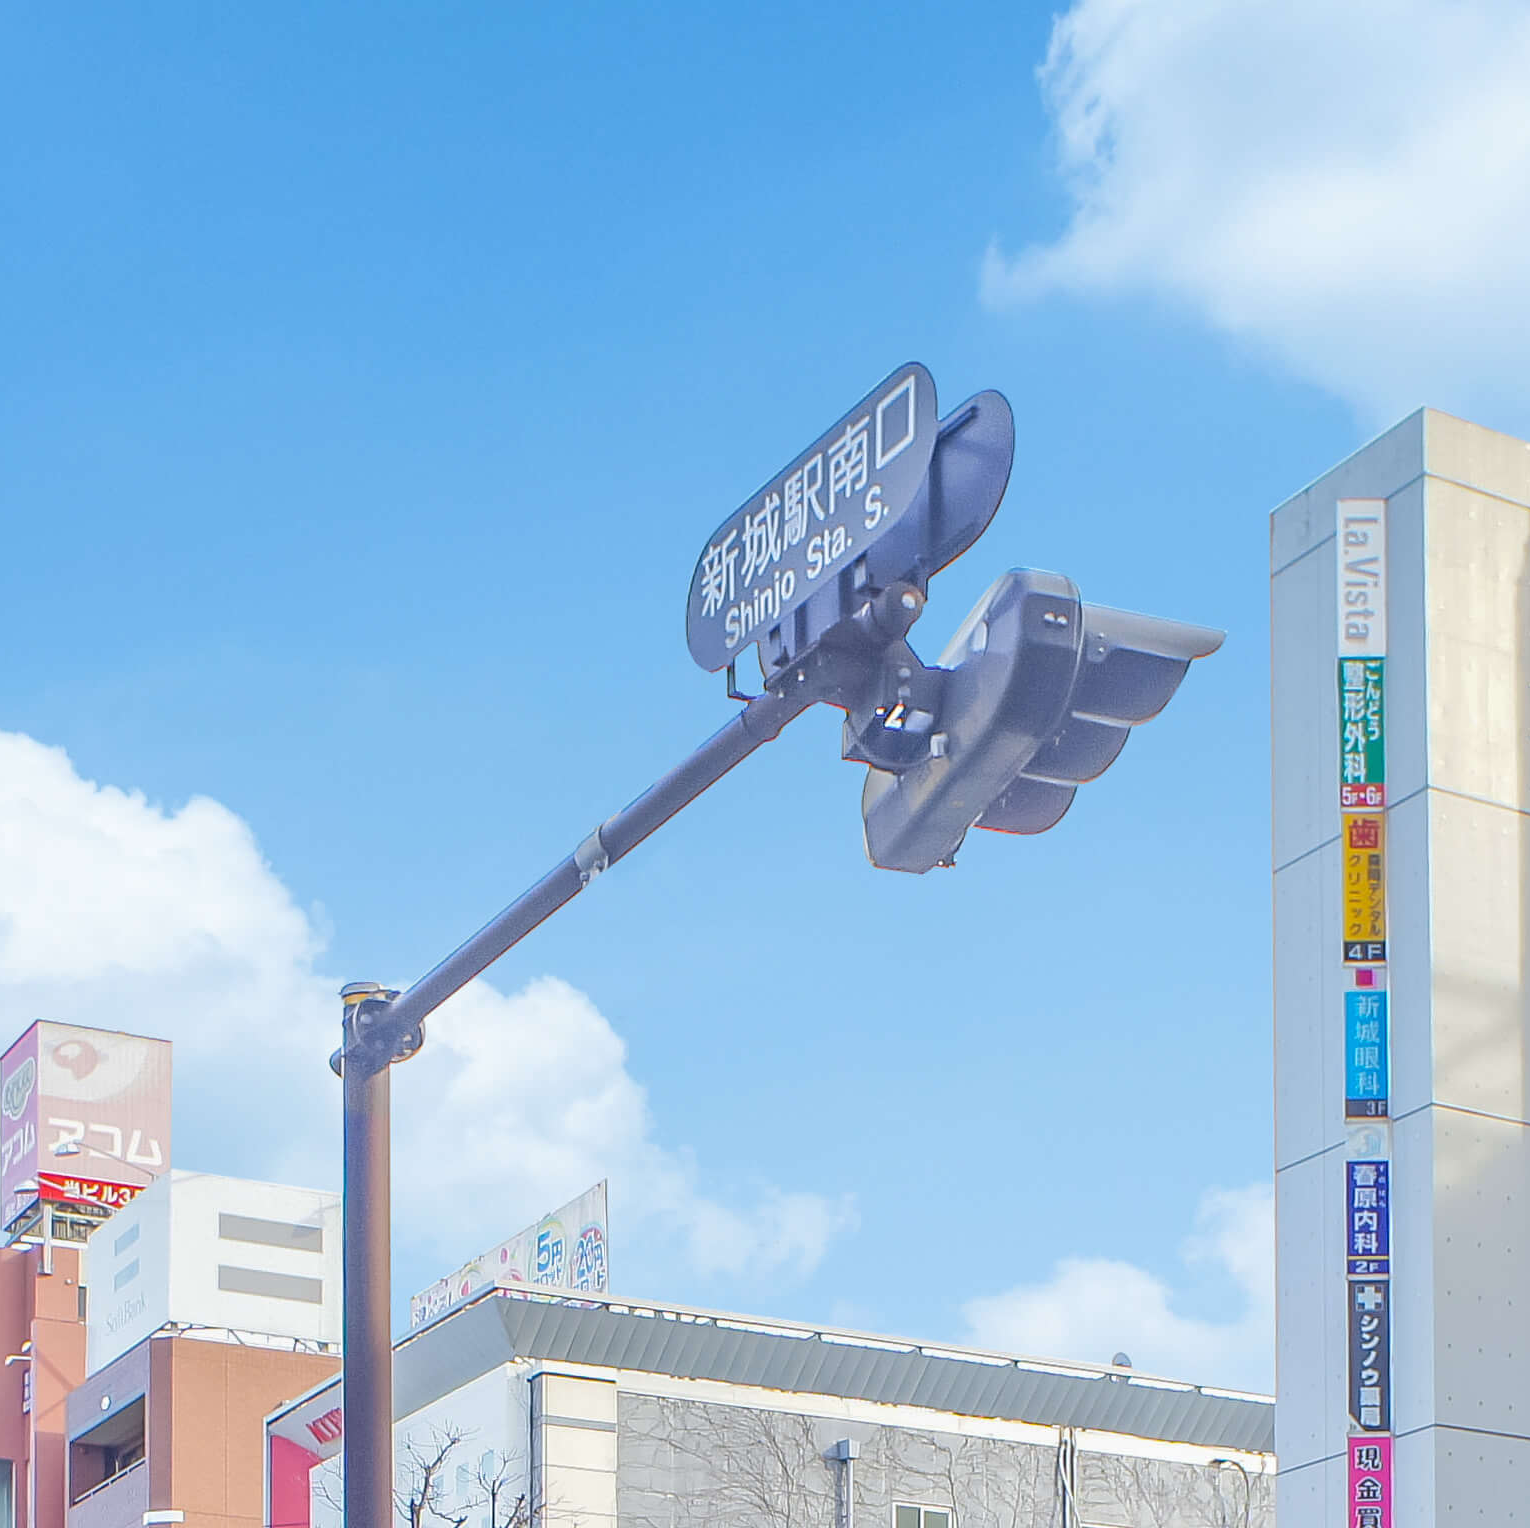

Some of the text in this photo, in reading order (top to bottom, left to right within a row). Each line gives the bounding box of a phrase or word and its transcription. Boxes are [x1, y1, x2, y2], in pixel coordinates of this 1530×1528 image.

[700, 374, 917, 618] 新城駅南口
[724, 485, 891, 649] Shinjo Sta. S.
[1348, 817, 1380, 849] 歯
[1348, 854, 1362, 936] クリニック
[1354, 994, 1380, 1095] 新城眼科
[1365, 1101, 1387, 1117] 3F
[1, 1121, 37, 1177] アコム
[47, 1118, 164, 1167] アコム
[1353, 1164, 1380, 1254] 春原内科
[536, 1230, 564, 1272] 5円
[1355, 1260, 1380, 1274] 2F
